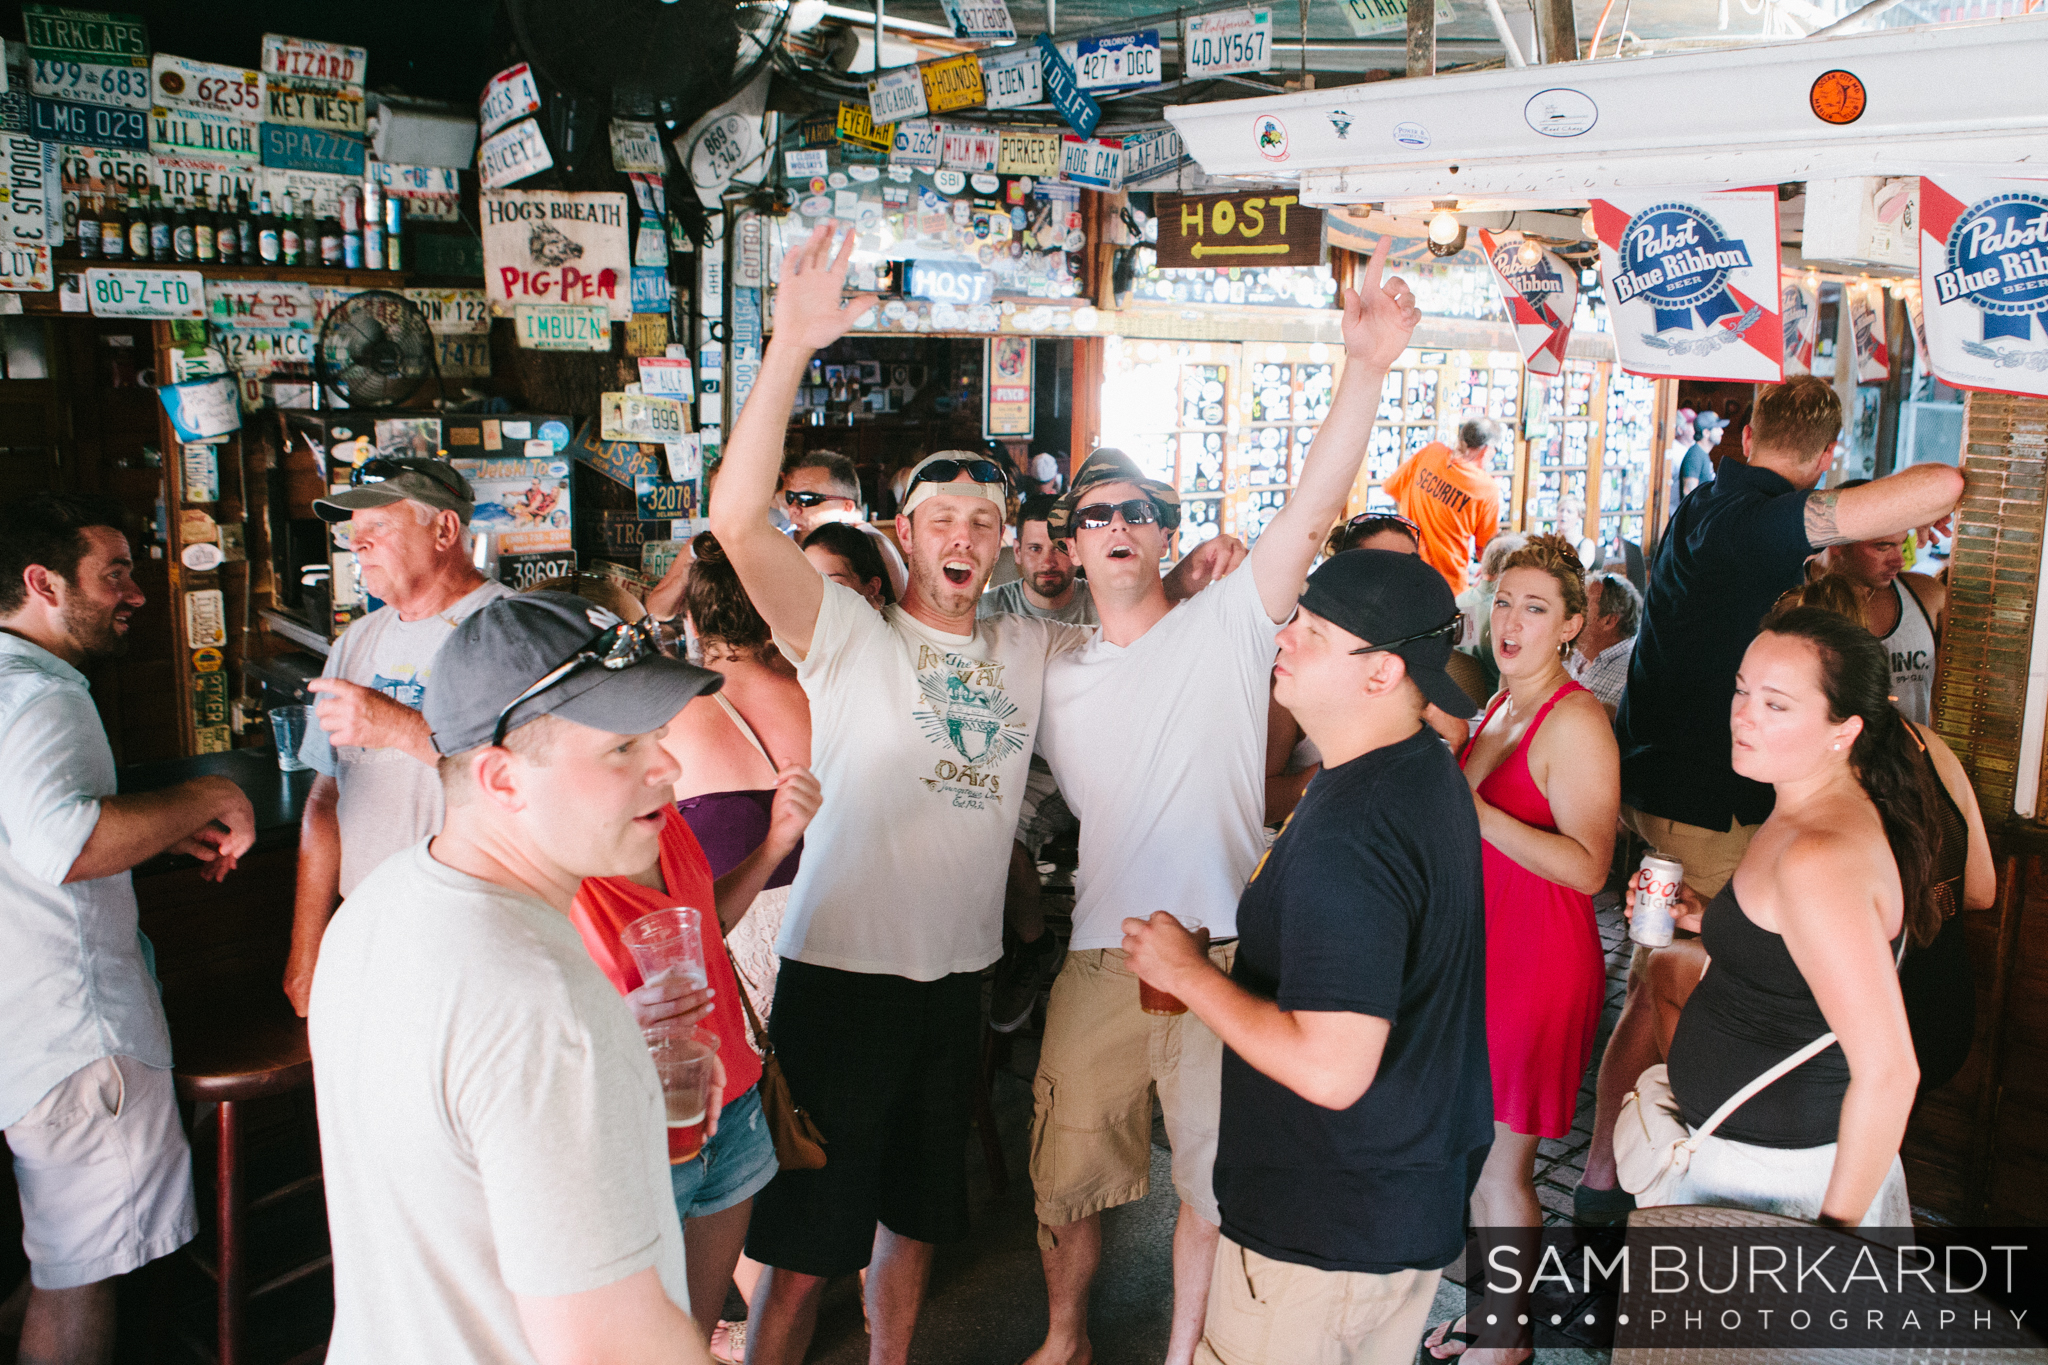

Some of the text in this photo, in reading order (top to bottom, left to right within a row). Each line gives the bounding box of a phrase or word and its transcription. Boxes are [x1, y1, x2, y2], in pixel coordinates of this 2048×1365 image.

[41, 19, 144, 54] TRKCAPS
[1099, 36, 1136, 48] COLORADO
[1204, 18, 1253, 36] California
[275, 46, 355, 82] WIZARD
[1191, 32, 1265, 67] 4DJY567
[1083, 50, 1154, 81] 427 DGC
[100, 68, 147, 98] 683
[197, 77, 260, 109] 6235
[998, 65, 1025, 97] EDEN
[62, 88, 122, 105] ONTARIO
[269, 91, 360, 127] KEY WEST
[872, 84, 919, 117] HUGAHOG
[36, 101, 87, 134] LMG
[95, 109, 144, 140] 029
[200, 121, 253, 153] HIGH
[703, 125, 728, 157] 869
[1002, 138, 1046, 165] PORKER
[1064, 145, 1089, 173] HOG
[98, 160, 149, 189] 956
[940, 172, 960, 187] SBI
[488, 200, 622, 228] HOG'S BREATH
[1180, 195, 1298, 238] HOST
[13, 224, 44, 240] 3
[1628, 217, 1700, 263] Pabst
[1960, 212, 2048, 260] Pabst
[1614, 246, 1748, 302] Blue Ribbon
[1666, 276, 1703, 292] BEER
[1936, 267, 2001, 303] Blue
[273, 294, 298, 318] 25
[456, 301, 486, 321] 122
[526, 314, 601, 340] IMBUZN
[652, 407, 679, 431] 899
[476, 458, 550, 479] Jetski To
[648, 485, 692, 510] 32078
[1415, 467, 1472, 513] SECURITY
[656, 510, 684, 518] DELAWARE
[945, 652, 973, 671] The
[934, 759, 1001, 794] OAKS
